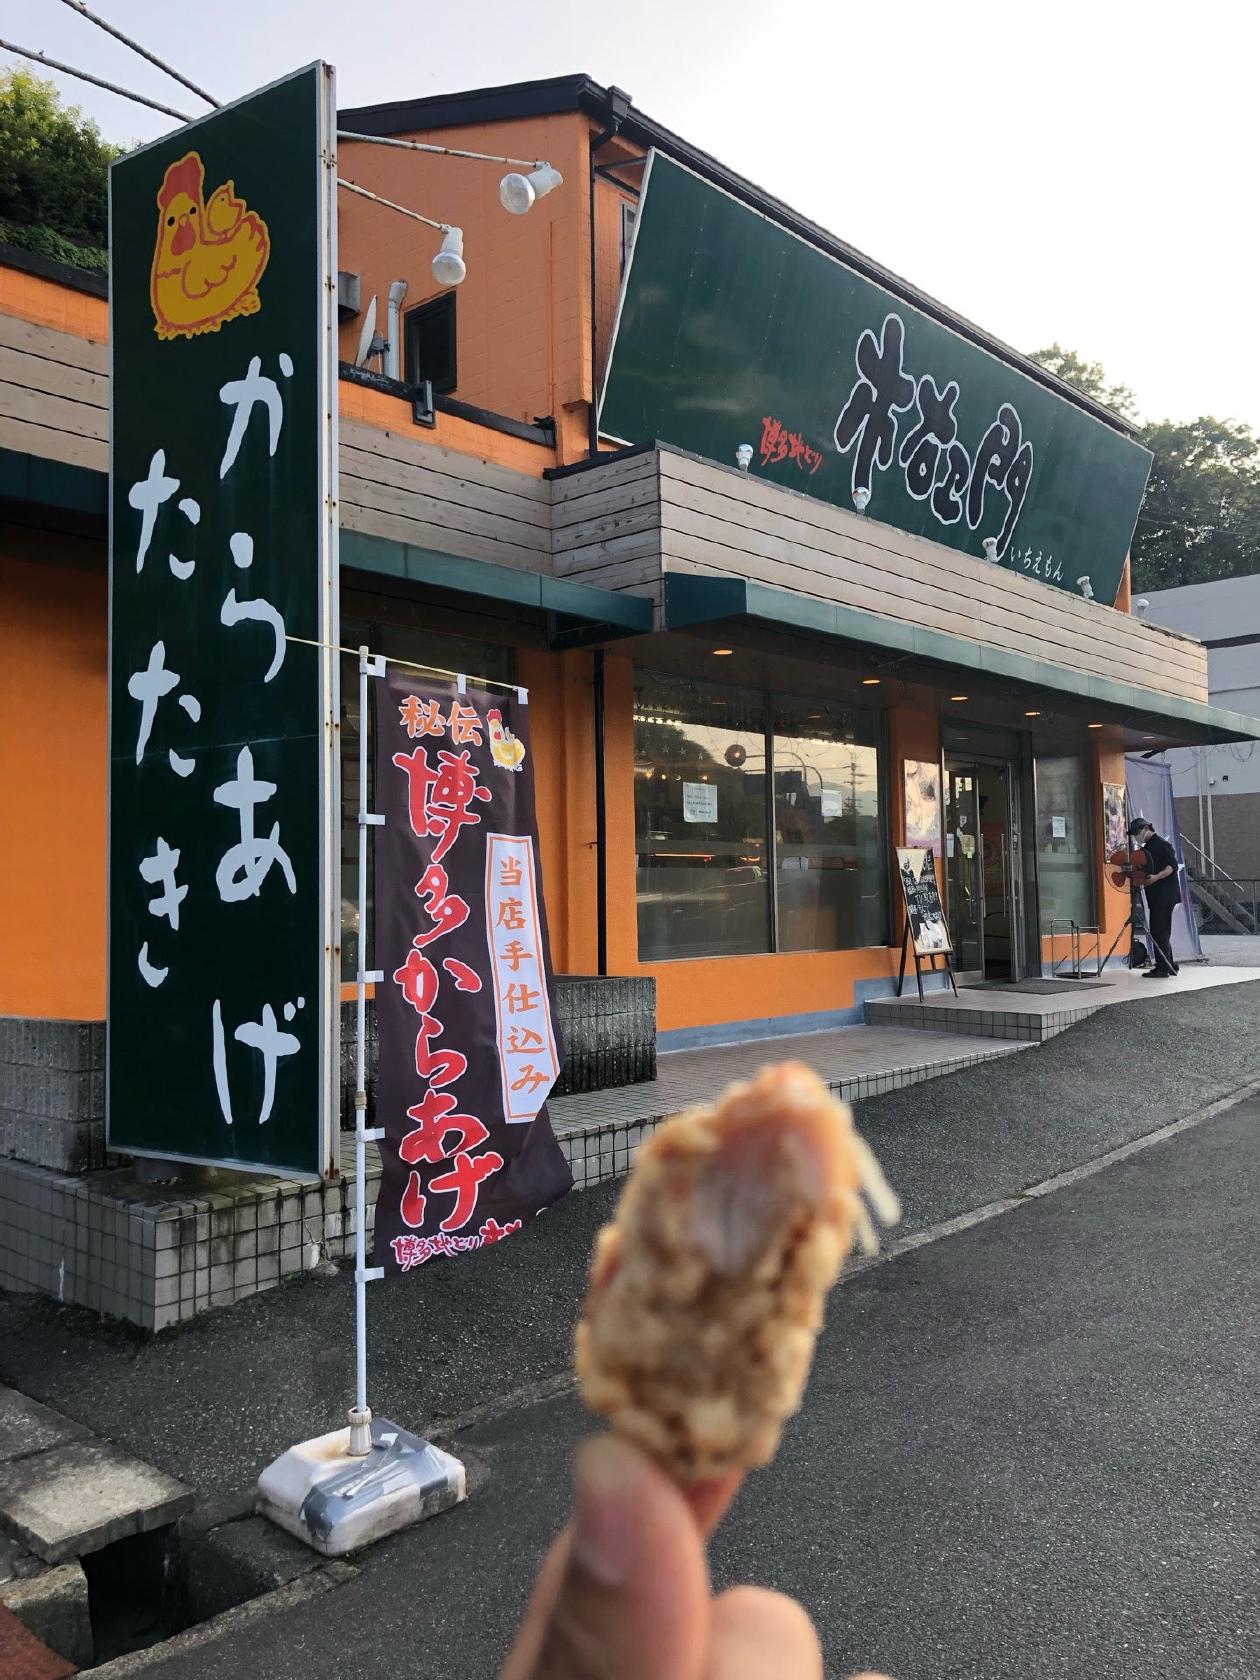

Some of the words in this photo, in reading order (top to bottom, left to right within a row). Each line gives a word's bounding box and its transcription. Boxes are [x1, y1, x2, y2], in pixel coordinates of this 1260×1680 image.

[128, 448, 201, 988] たたき
[212, 351, 305, 1124] からあげ
[398, 694, 483, 746] 秘伝
[1010, 546, 1064, 581] いちえもん
[392, 746, 504, 1231] 博多からあげ
[495, 855, 551, 1095] 当店手仕込み
